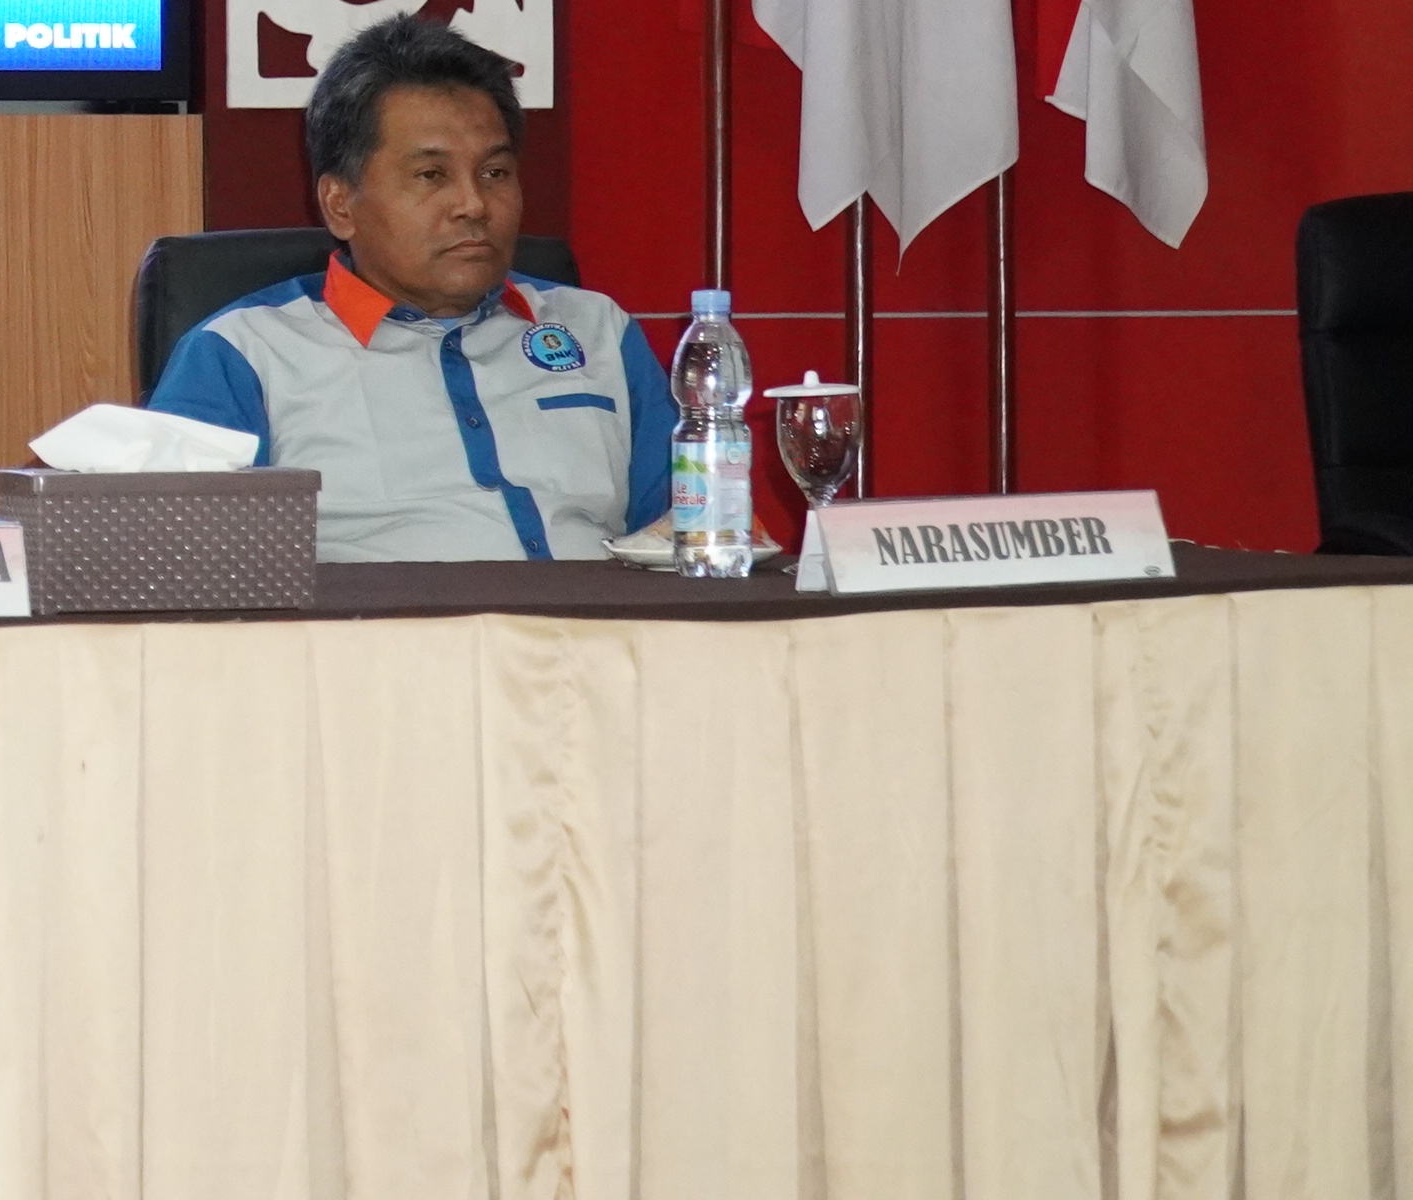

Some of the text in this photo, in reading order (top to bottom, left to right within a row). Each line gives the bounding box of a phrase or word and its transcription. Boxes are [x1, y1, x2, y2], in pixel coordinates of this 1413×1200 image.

[5, 22, 137, 49] POLITIK
[545, 349, 575, 361] BNK
[871, 516, 1114, 566] NARASUMBER
